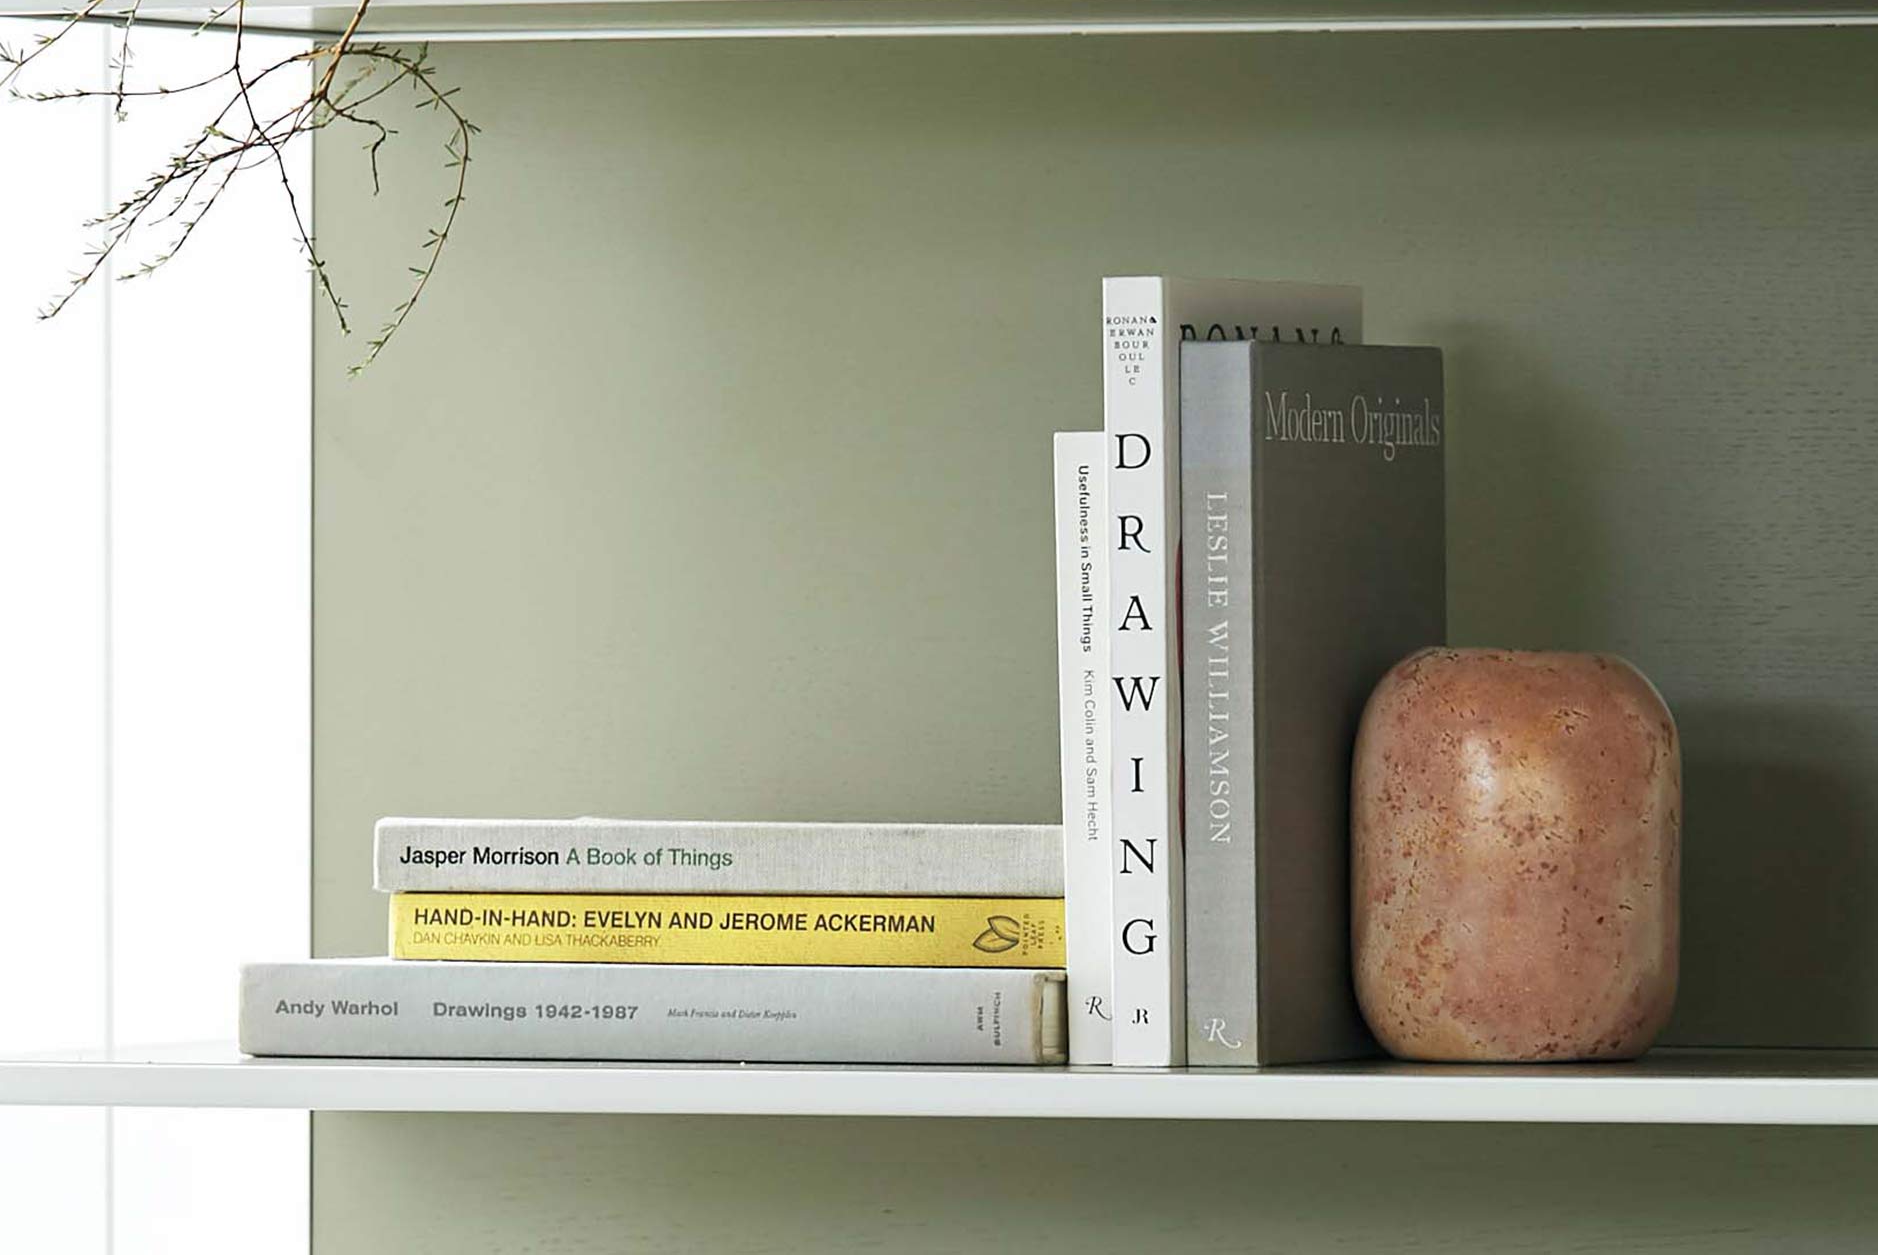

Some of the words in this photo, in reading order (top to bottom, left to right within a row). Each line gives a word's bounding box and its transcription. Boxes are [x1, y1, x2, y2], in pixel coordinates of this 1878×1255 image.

[1265, 391, 1346, 443] Modern
[1351, 395, 1440, 461] Originals
[1078, 465, 1090, 542] Usefulness
[1081, 546, 1090, 558] in
[1206, 492, 1228, 607] LESLIE
[1081, 562, 1092, 601] Small
[1080, 604, 1093, 653] Things
[1084, 670, 1094, 696] Kim
[1112, 433, 1160, 955] DRAWING
[1085, 699, 1096, 734] Colin
[1207, 620, 1231, 843] WILLIAMSON
[1086, 739, 1096, 763] and
[1086, 768, 1097, 797] Sam
[1088, 802, 1099, 840] Hecht
[400, 846, 466, 868] Jasper
[473, 847, 559, 865] Morrison
[566, 848, 580, 865] A
[587, 848, 636, 865] Book
[644, 848, 663, 865] of
[668, 848, 733, 870] Things
[415, 908, 576, 927] HAND-IN-HAND:
[584, 910, 661, 928] EVELYN
[669, 912, 713, 929] AND
[720, 913, 807, 931] JEROME
[814, 914, 935, 933] ACKERMAN
[413, 931, 440, 945] DAN
[444, 932, 500, 946] CHAVKIN
[503, 933, 531, 947] AND
[534, 933, 562, 948] LISA
[566, 934, 661, 949] THACKABERRY
[275, 1000, 325, 1018] Andy
[332, 1000, 398, 1016] Warhol
[433, 1002, 527, 1021] Drawings
[536, 1004, 638, 1020] 1942-1987
